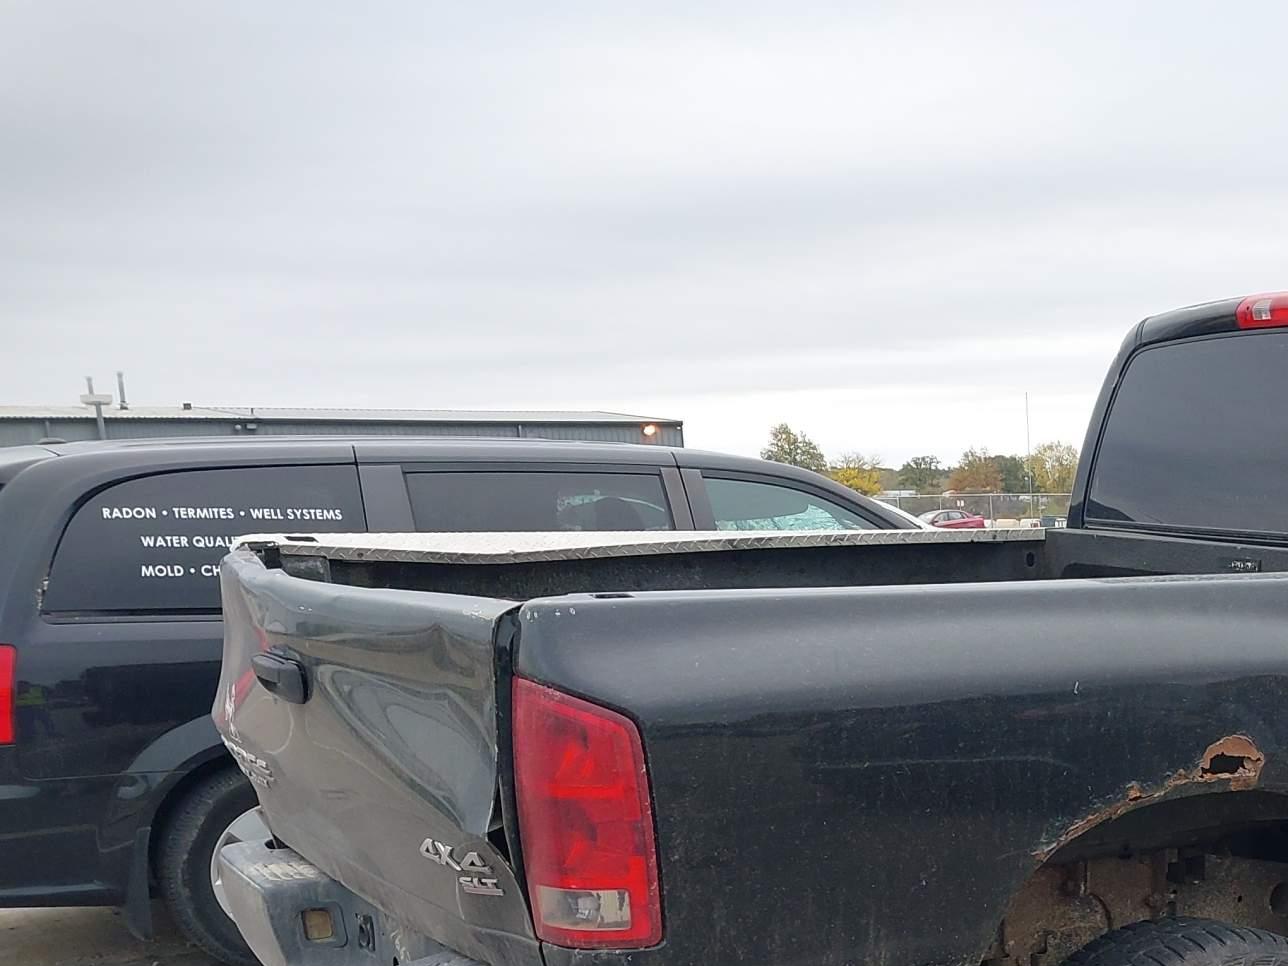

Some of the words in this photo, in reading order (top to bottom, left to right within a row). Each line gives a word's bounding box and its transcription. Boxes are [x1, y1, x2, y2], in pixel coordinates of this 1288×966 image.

[102, 507, 157, 519] RADON
[173, 507, 235, 520] TERMITES
[250, 508, 284, 520] WELL
[287, 508, 343, 521] SYSTEMS
[141, 535, 189, 548] WATER
[141, 565, 184, 577] MOLD
[420, 838, 492, 875] 4X4
[459, 876, 500, 891] SLT
